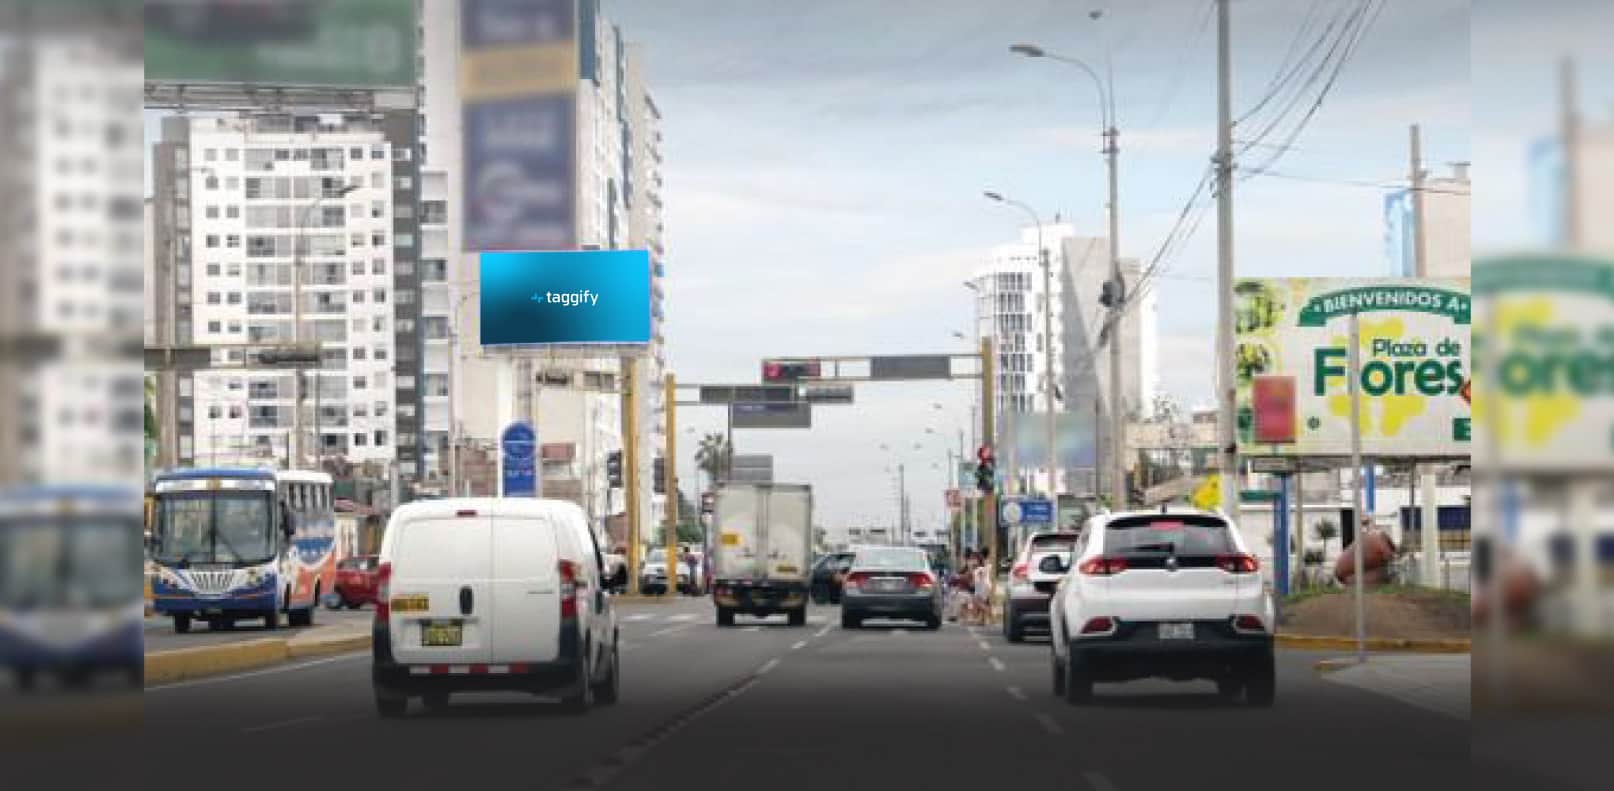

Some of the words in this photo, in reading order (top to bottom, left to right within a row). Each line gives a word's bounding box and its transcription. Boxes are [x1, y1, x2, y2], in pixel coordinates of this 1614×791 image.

[546, 289, 598, 306] taggify
[1324, 291, 1441, 312] BIENVENIDOS
[1447, 296, 1460, 310] A
[1372, 338, 1427, 357] Plaza
[1436, 337, 1461, 356] de
[1314, 348, 1465, 396] Fores
